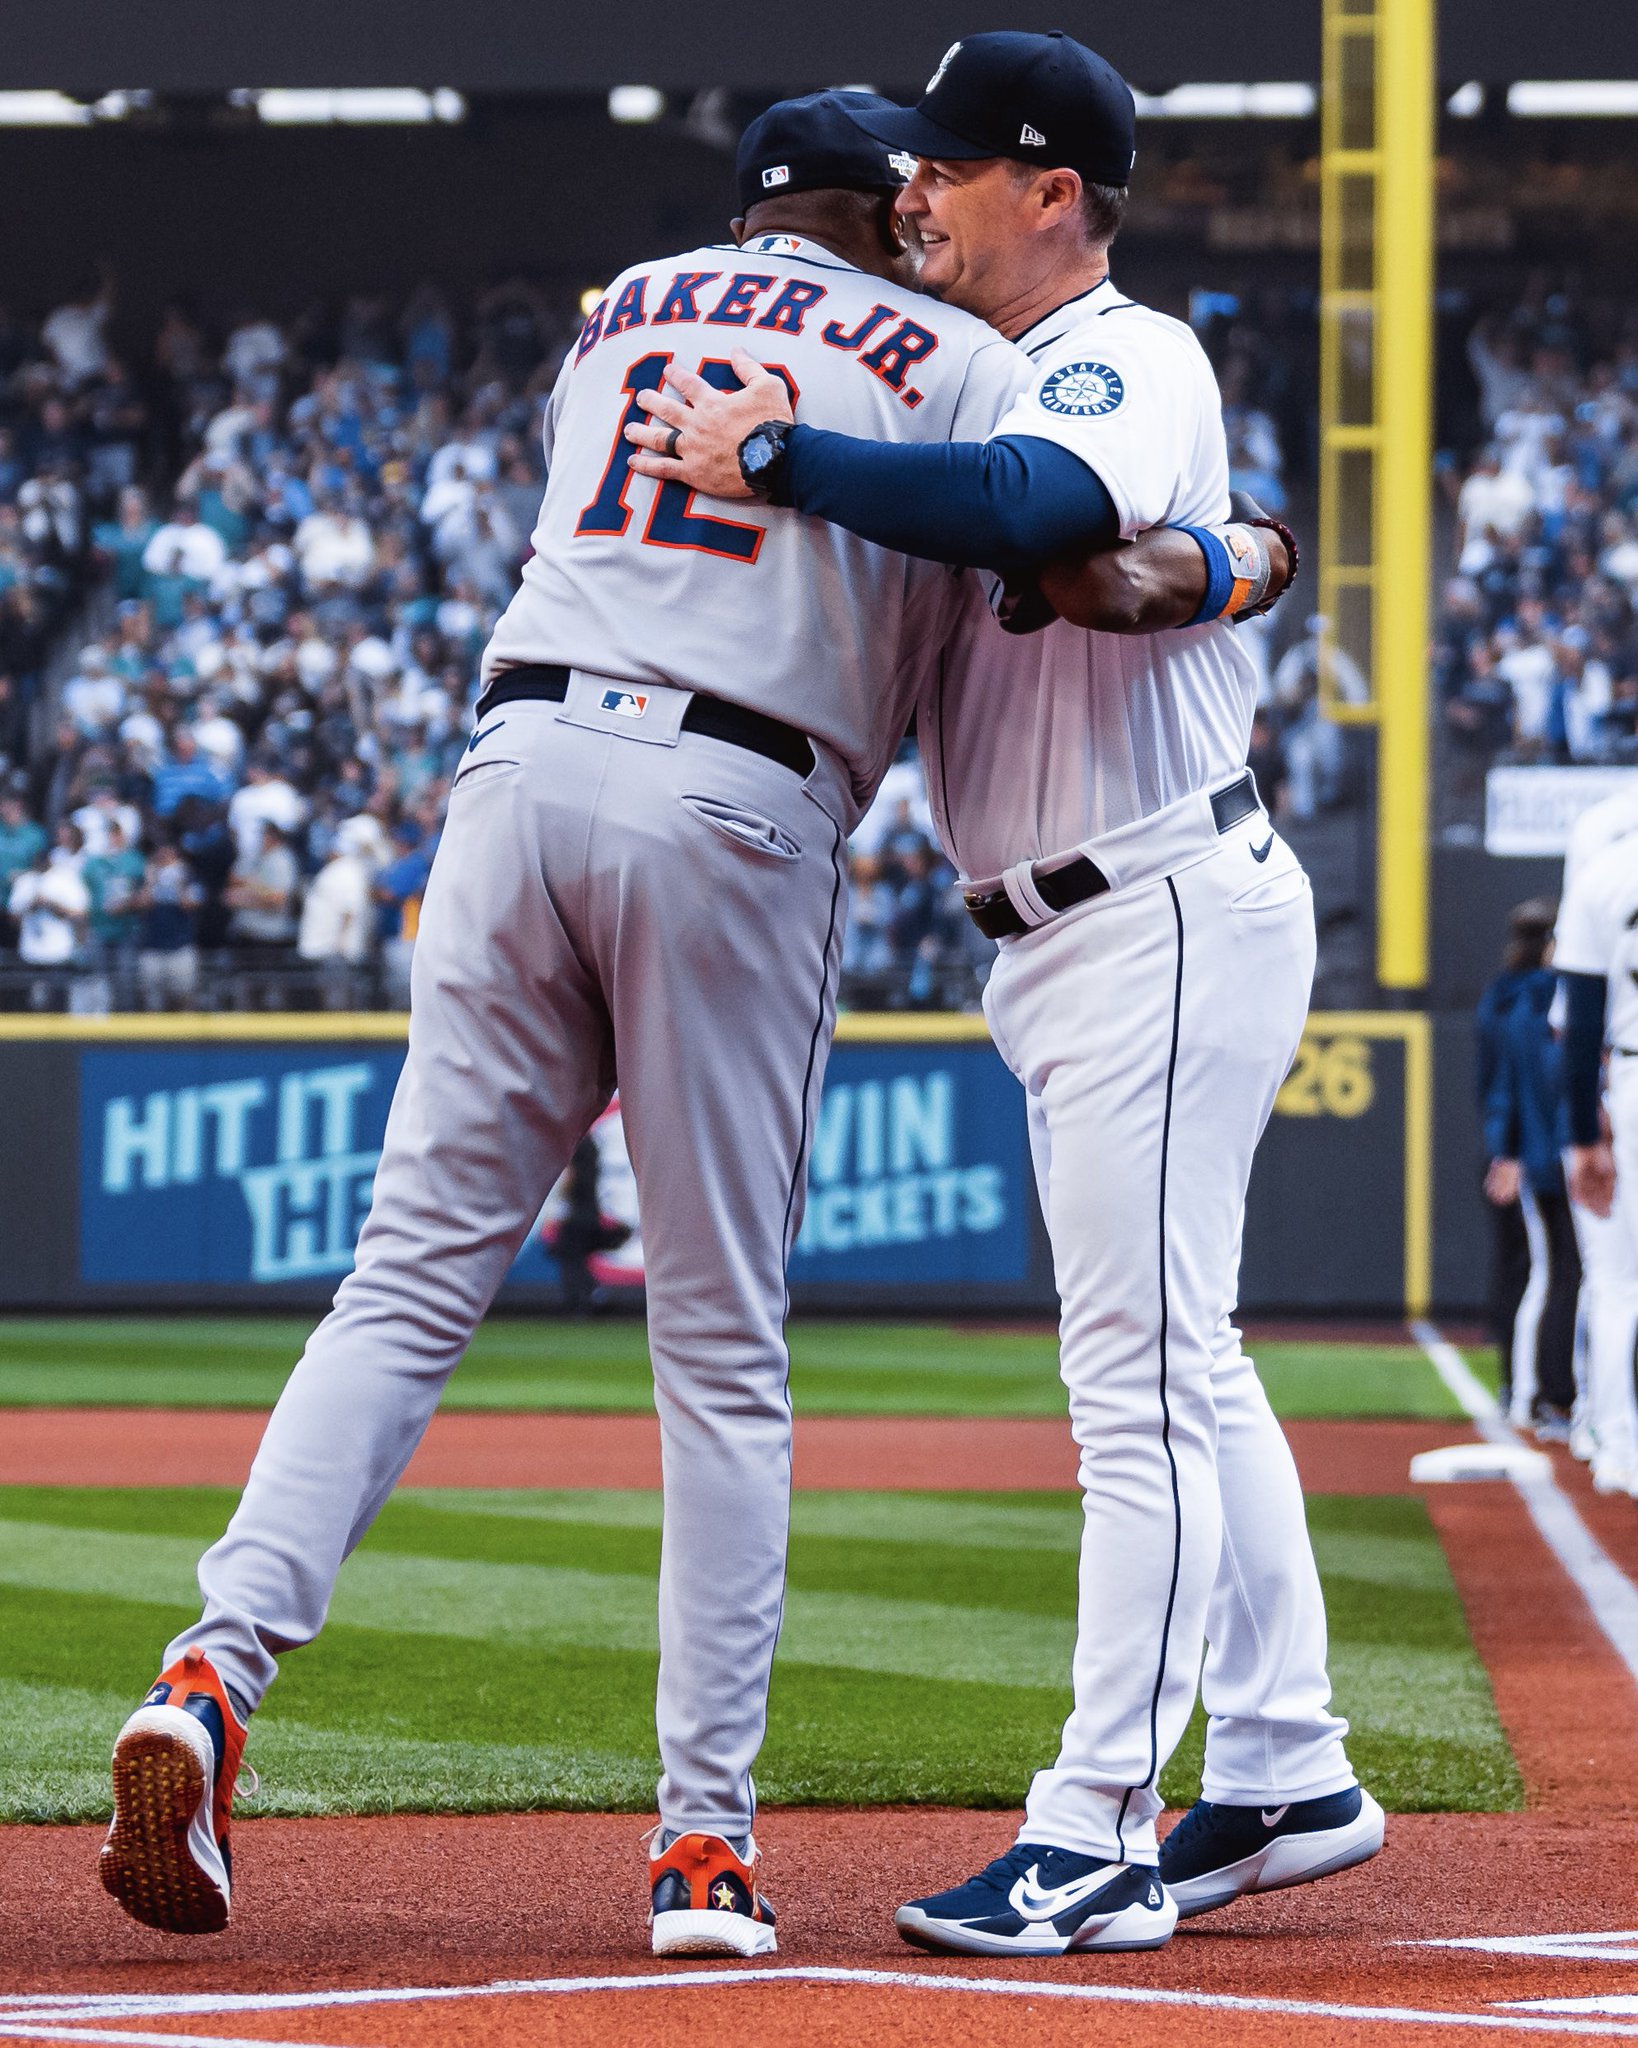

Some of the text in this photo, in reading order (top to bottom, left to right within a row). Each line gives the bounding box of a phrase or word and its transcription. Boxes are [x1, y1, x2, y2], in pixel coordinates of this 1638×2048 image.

[573, 271, 939, 410] BAKER JR.
[1053, 363, 1122, 394] SEATTLE
[572, 351, 801, 565] 12
[1042, 390, 1112, 415] MARINERS
[103, 1061, 374, 1194] HIT IT
[797, 1164, 1004, 1255] ICKETS
